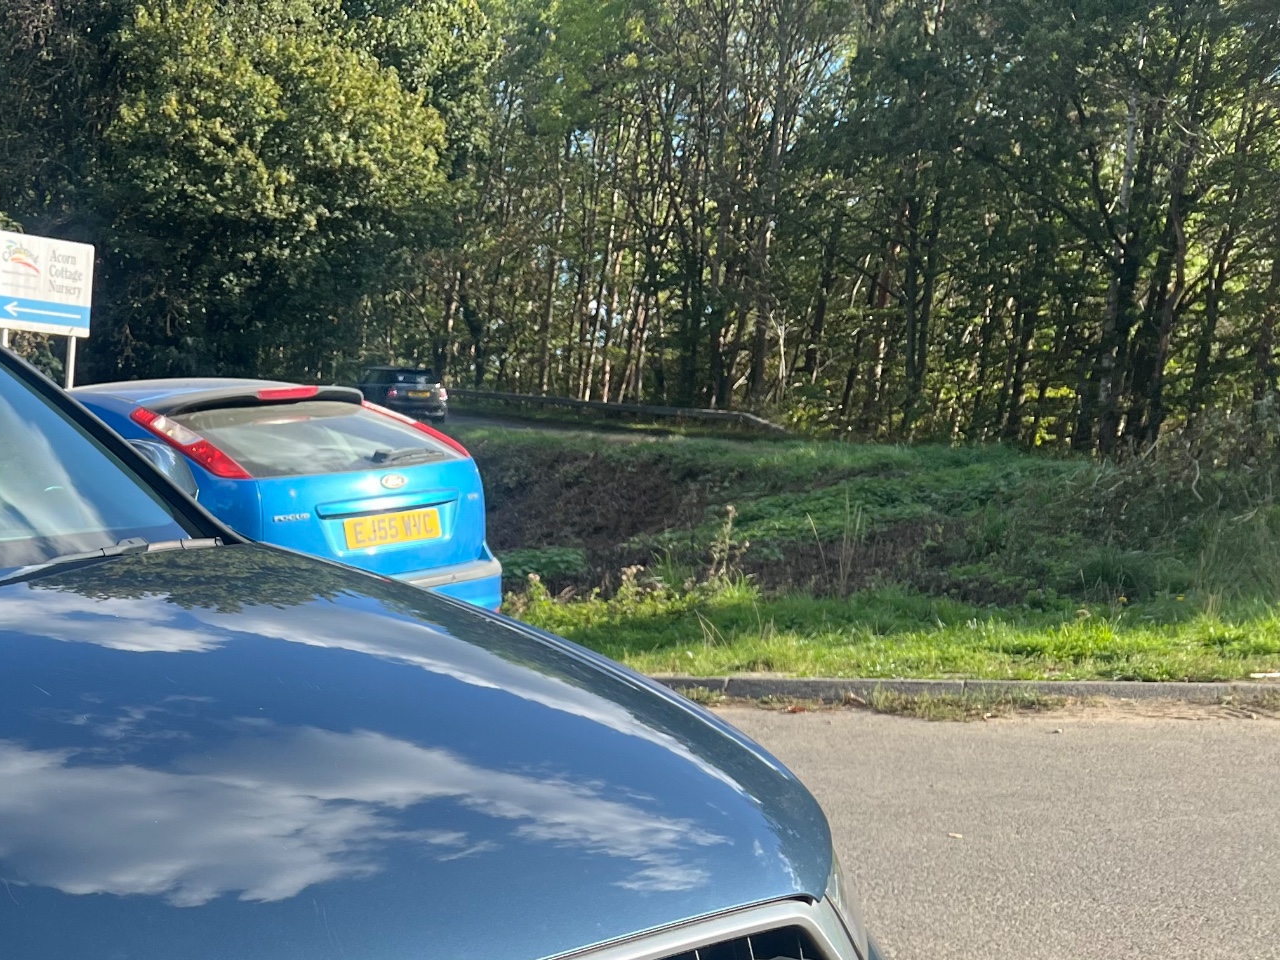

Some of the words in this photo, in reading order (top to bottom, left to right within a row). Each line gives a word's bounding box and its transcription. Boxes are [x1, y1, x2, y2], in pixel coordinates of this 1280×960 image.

[49, 249, 77, 266] Acorn
[48, 264, 83, 283] Cottage
[48, 279, 82, 298] Nursery
[353, 517, 399, 544] EJ55
[402, 513, 434, 537] WVC
